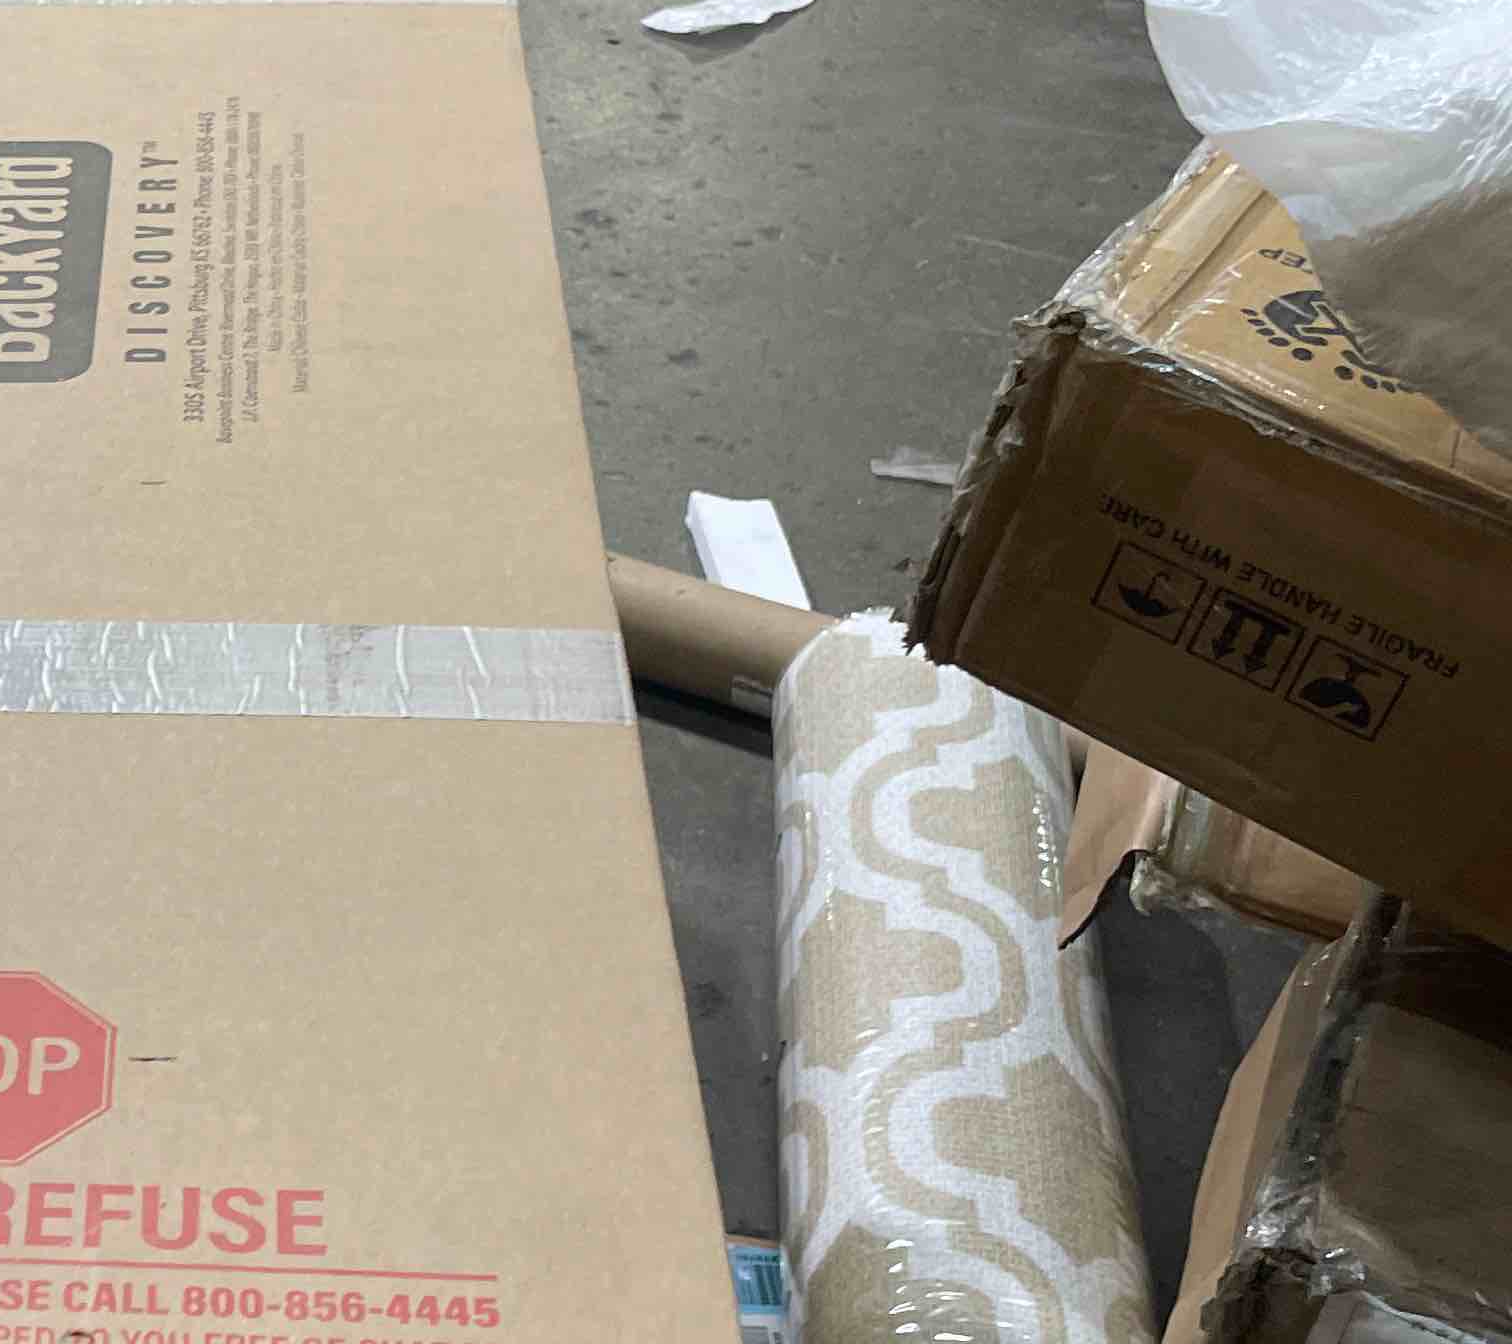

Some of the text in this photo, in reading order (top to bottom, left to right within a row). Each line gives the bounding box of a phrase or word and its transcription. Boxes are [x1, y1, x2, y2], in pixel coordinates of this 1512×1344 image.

[124, 155, 179, 364] DISCOVERY
[184, 348, 211, 391] Airport
[1098, 492, 1163, 538] CARE
[1170, 526, 1232, 574] WITH
[1238, 560, 1341, 625] HANDLE
[62, 1281, 169, 1317] CALL
[181, 1286, 501, 1328] 800-856-4445
